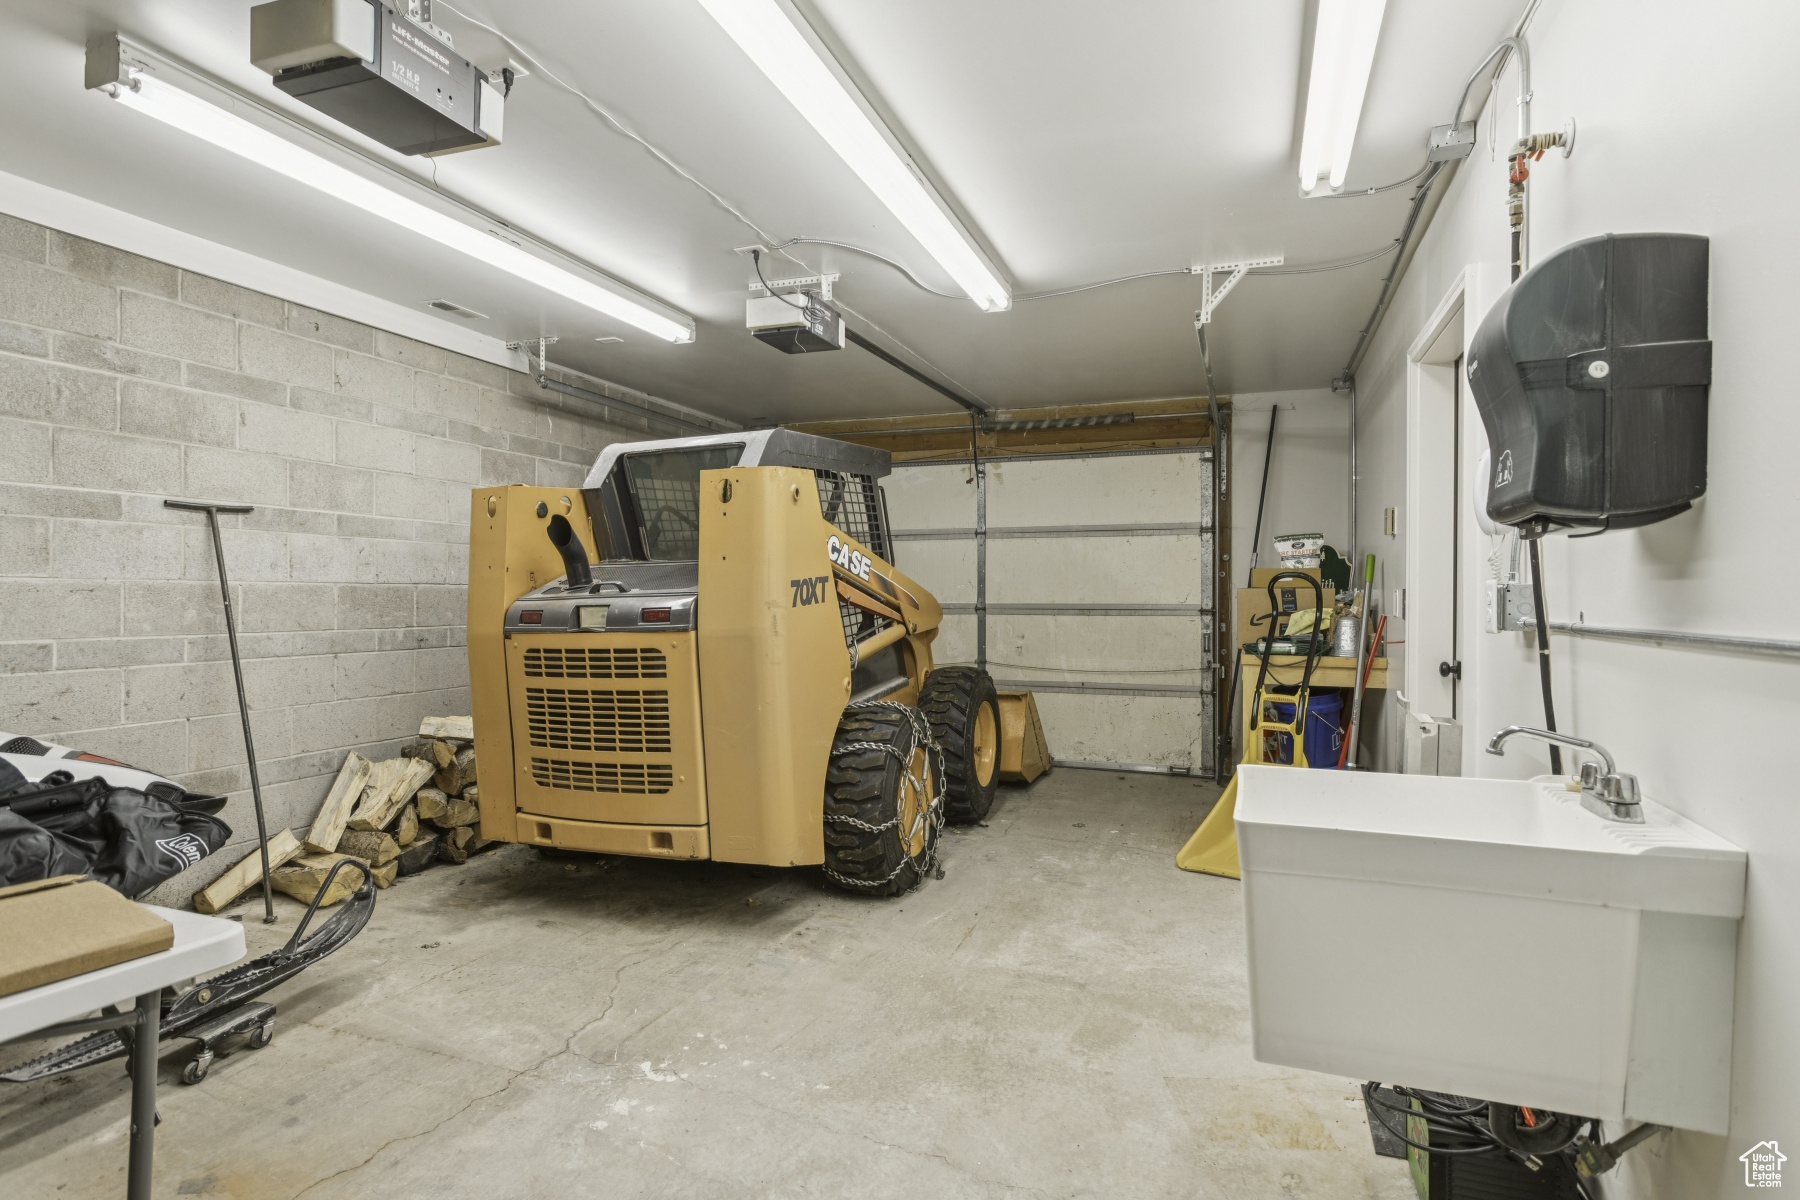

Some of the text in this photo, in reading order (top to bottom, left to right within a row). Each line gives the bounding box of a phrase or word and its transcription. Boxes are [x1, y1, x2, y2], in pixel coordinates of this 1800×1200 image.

[391, 60, 405, 77] 1/2
[827, 535, 872, 582] CASE
[790, 575, 829, 608] 70XT
